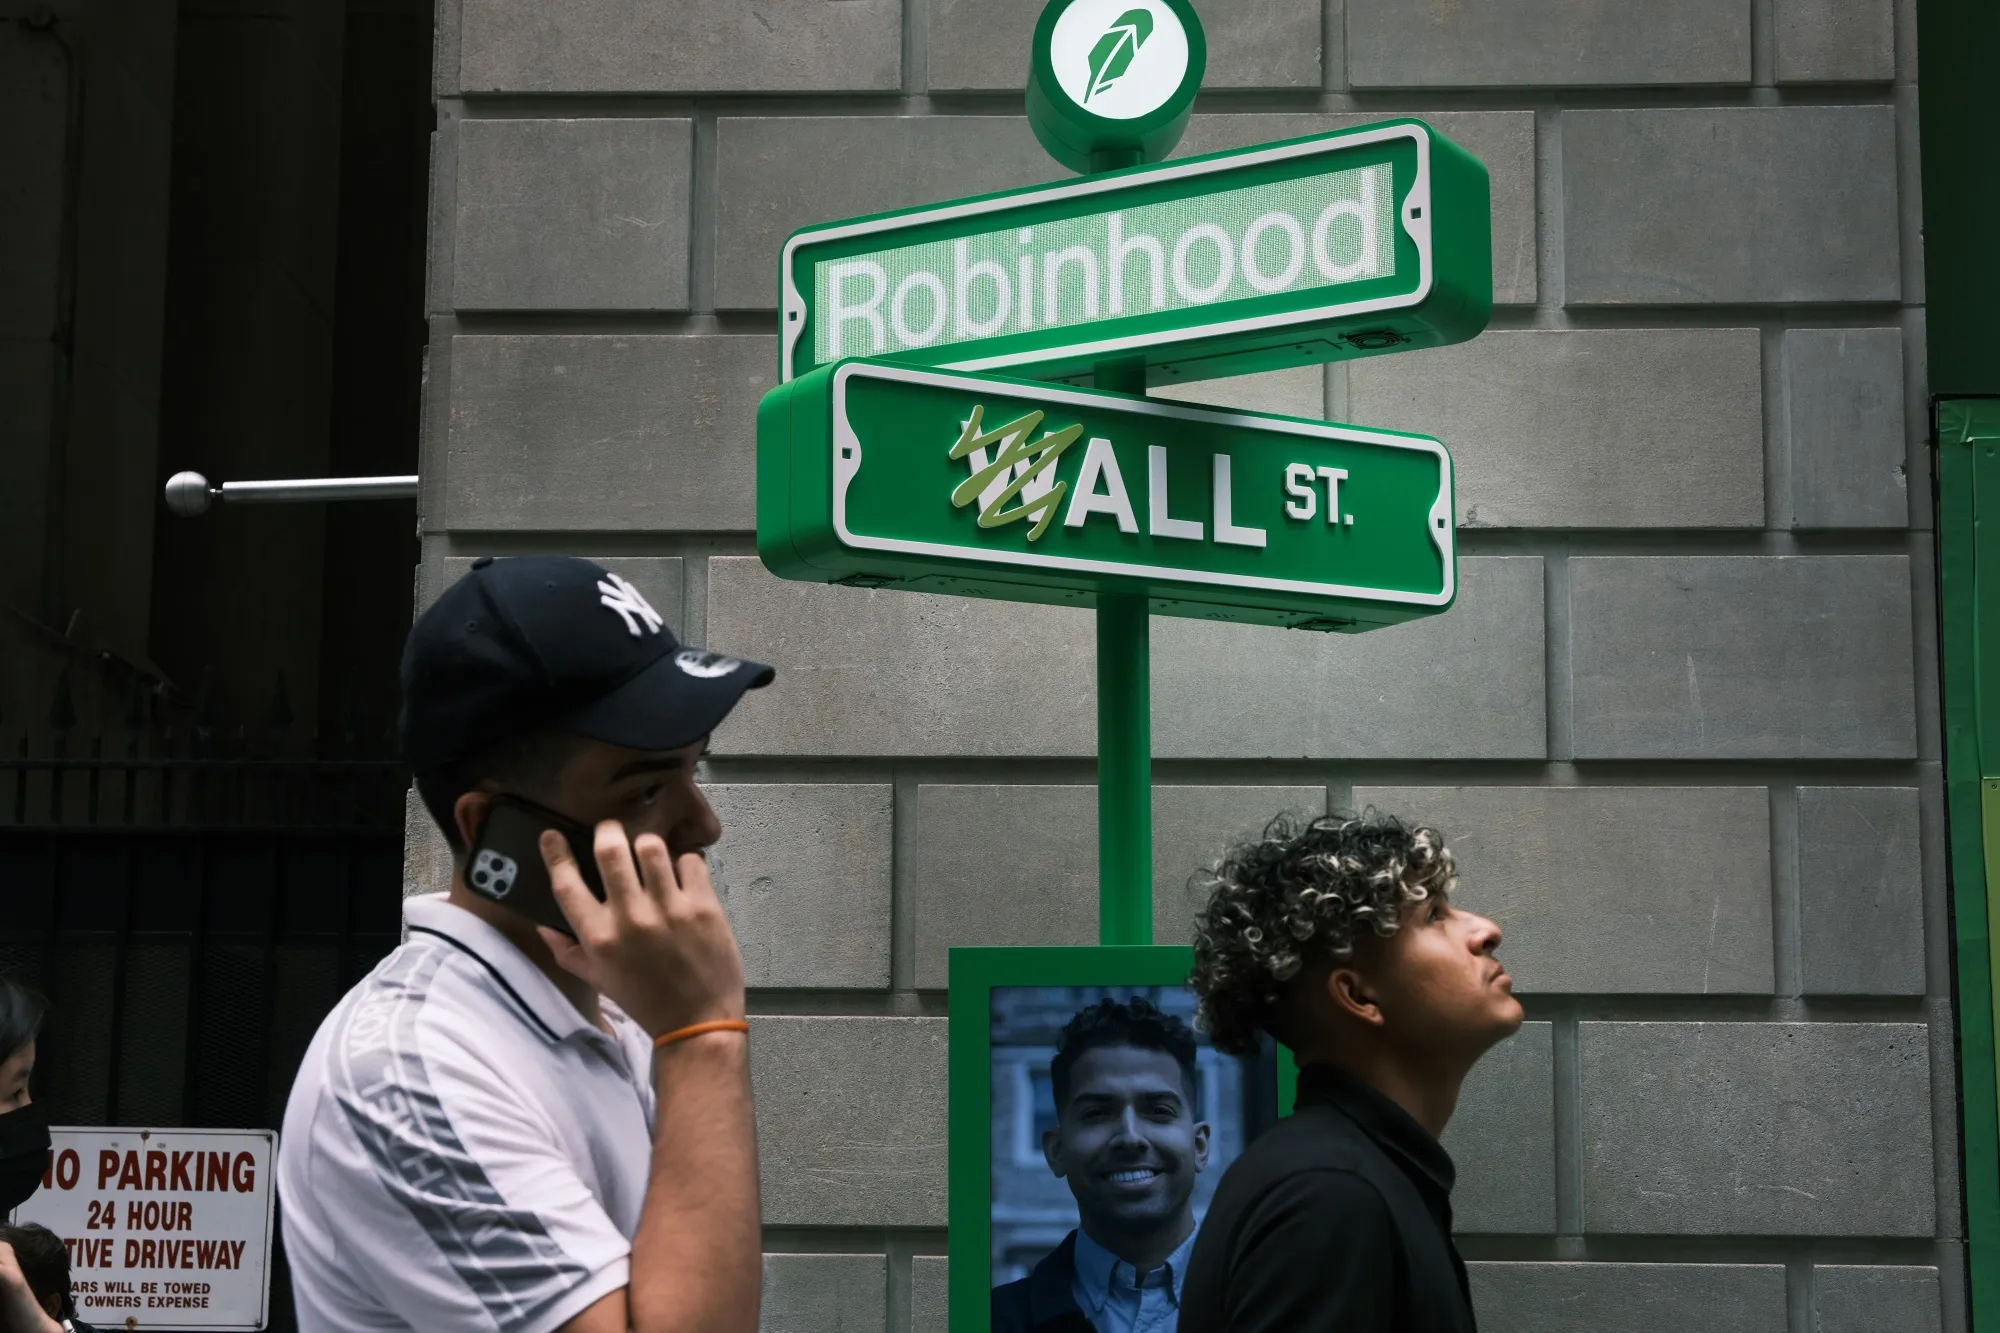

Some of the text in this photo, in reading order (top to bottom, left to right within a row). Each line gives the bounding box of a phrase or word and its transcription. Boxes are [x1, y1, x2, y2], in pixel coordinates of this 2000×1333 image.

[827, 166, 1377, 358] Robinhood
[960, 420, 1353, 548] WALL ST.
[98, 1150, 255, 1192] PARKING
[87, 1200, 192, 1231] 24 HOUR
[64, 1239, 245, 1269] TIVE DRIVEWAY
[71, 1282, 210, 1294] ARS WILL BE TOWED
[84, 1296, 144, 1308] OWNERS
[148, 1297, 208, 1308] EXPENSE
